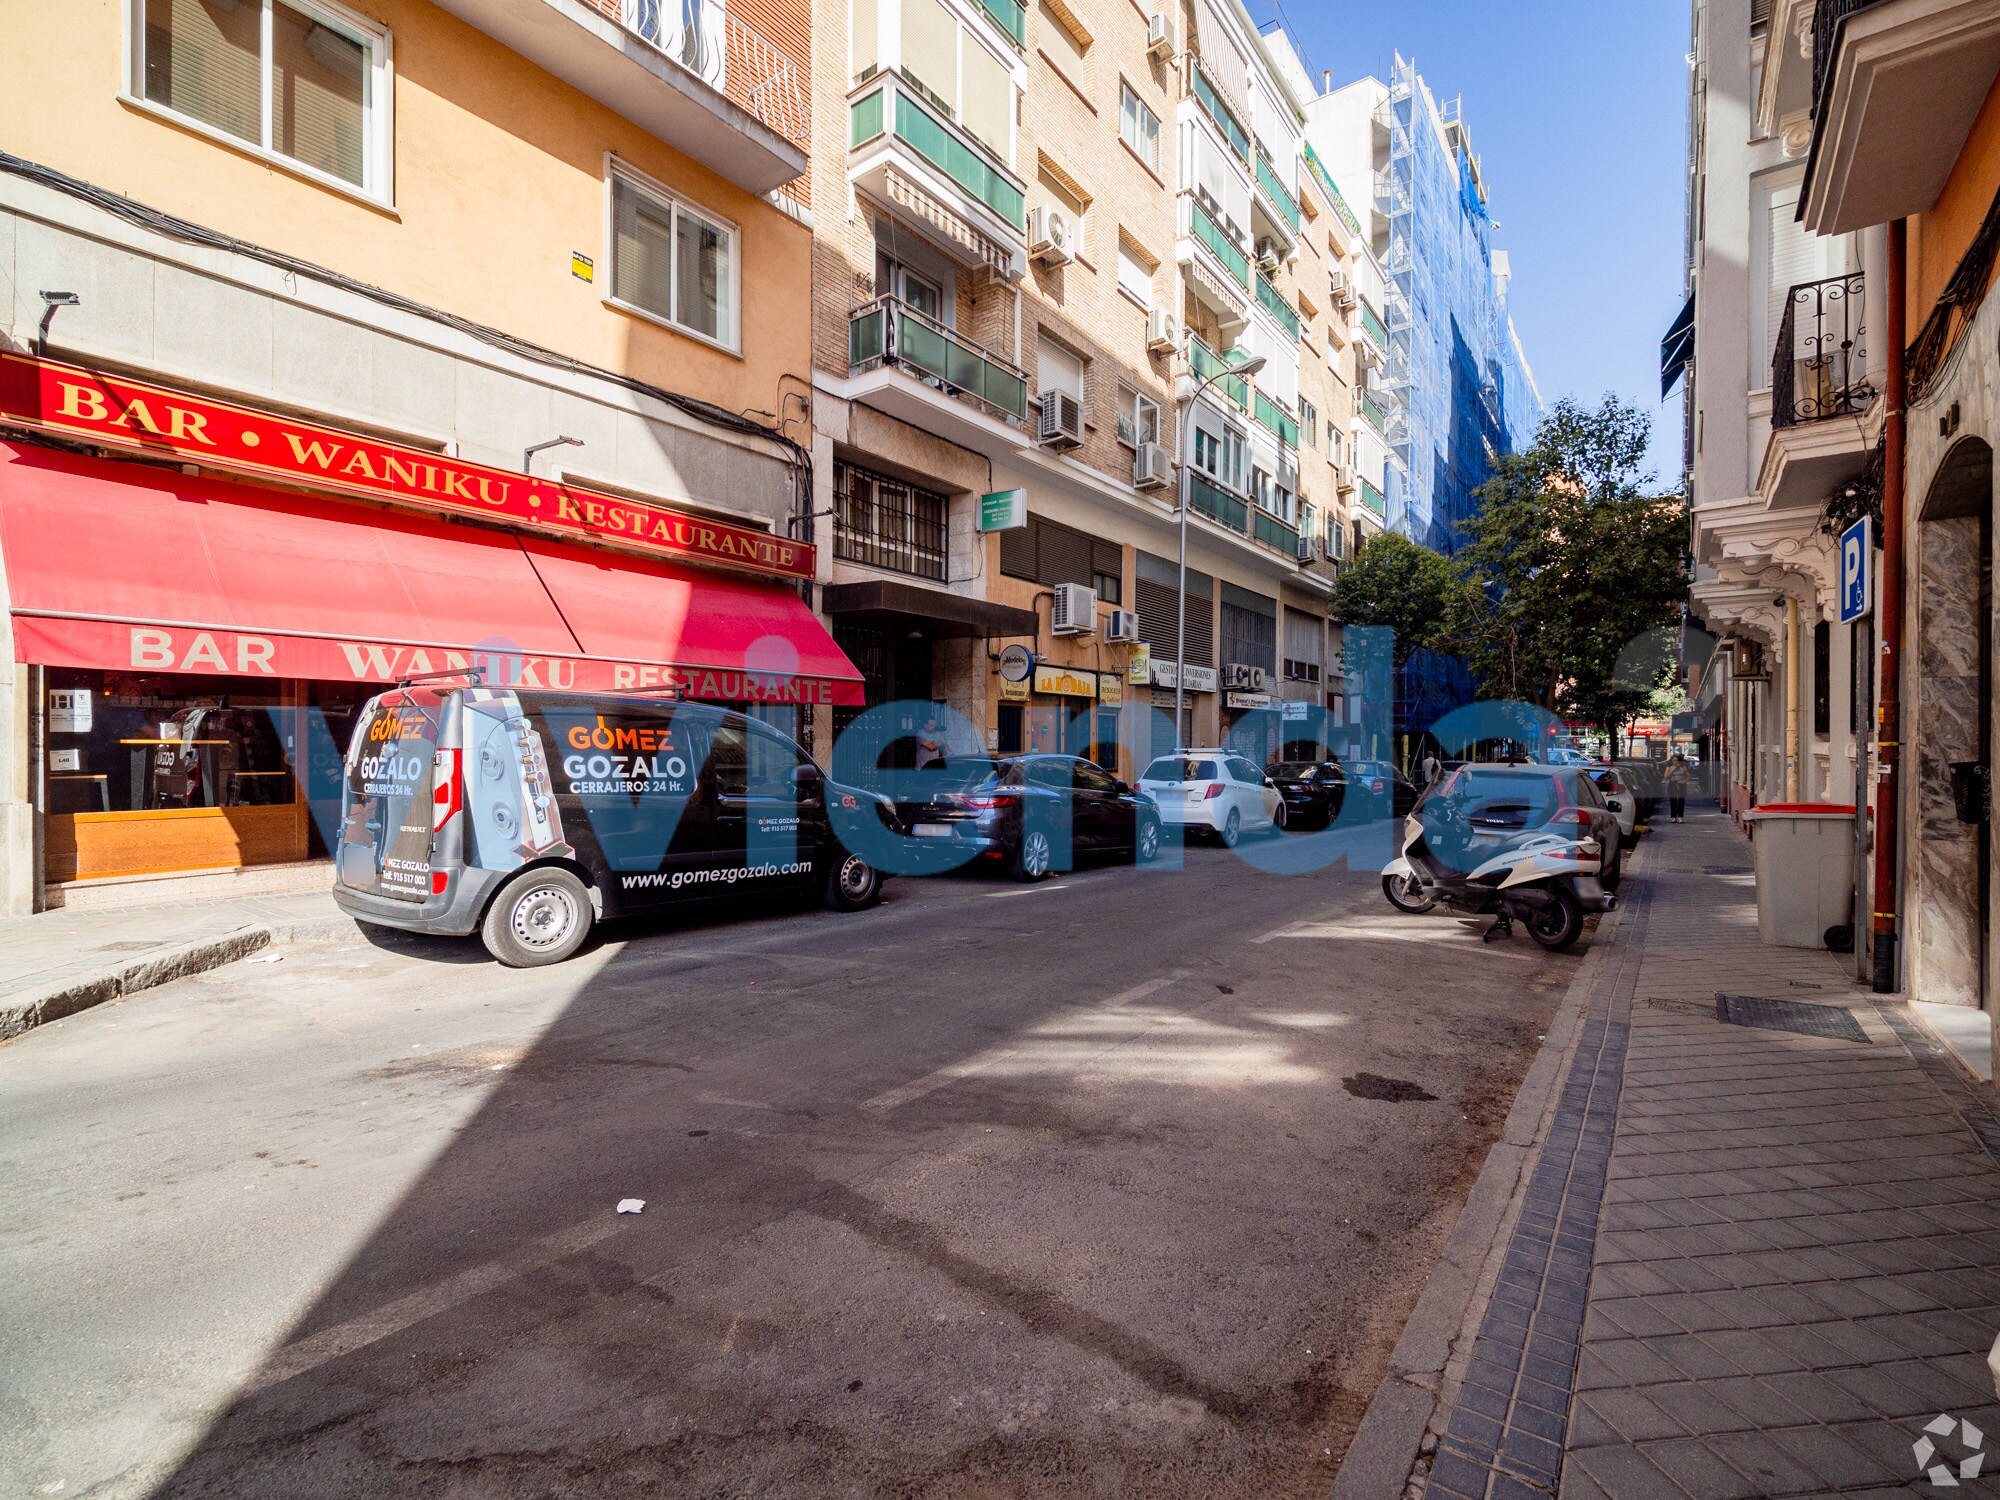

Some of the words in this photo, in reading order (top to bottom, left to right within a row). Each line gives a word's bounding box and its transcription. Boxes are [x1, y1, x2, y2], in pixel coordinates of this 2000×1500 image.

[55, 381, 217, 446] BAR
[281, 432, 511, 505] WANIKU
[556, 495, 794, 567] RESTAURANTE
[1845, 536, 1860, 610] P
[131, 628, 276, 674] BAR
[337, 642, 577, 690] WANIKU
[614, 664, 833, 704] RESTAURANTE
[1041, 677, 1053, 691] LA
[361, 757, 422, 781] GOZALO
[563, 755, 686, 779] GOZALO
[364, 782, 394, 795] CERRAJEROS
[395, 783, 403, 795] 24
[569, 780, 650, 794] CERRAJEROS
[652, 781, 666, 792] 24
[669, 780, 684, 792] Hr.
[399, 825, 427, 833] RENAULT
[401, 860, 430, 872] GOZALO
[621, 861, 812, 890] www.gomezgozalo.com
[404, 874, 414, 884] 517
[414, 876, 426, 886] 003
